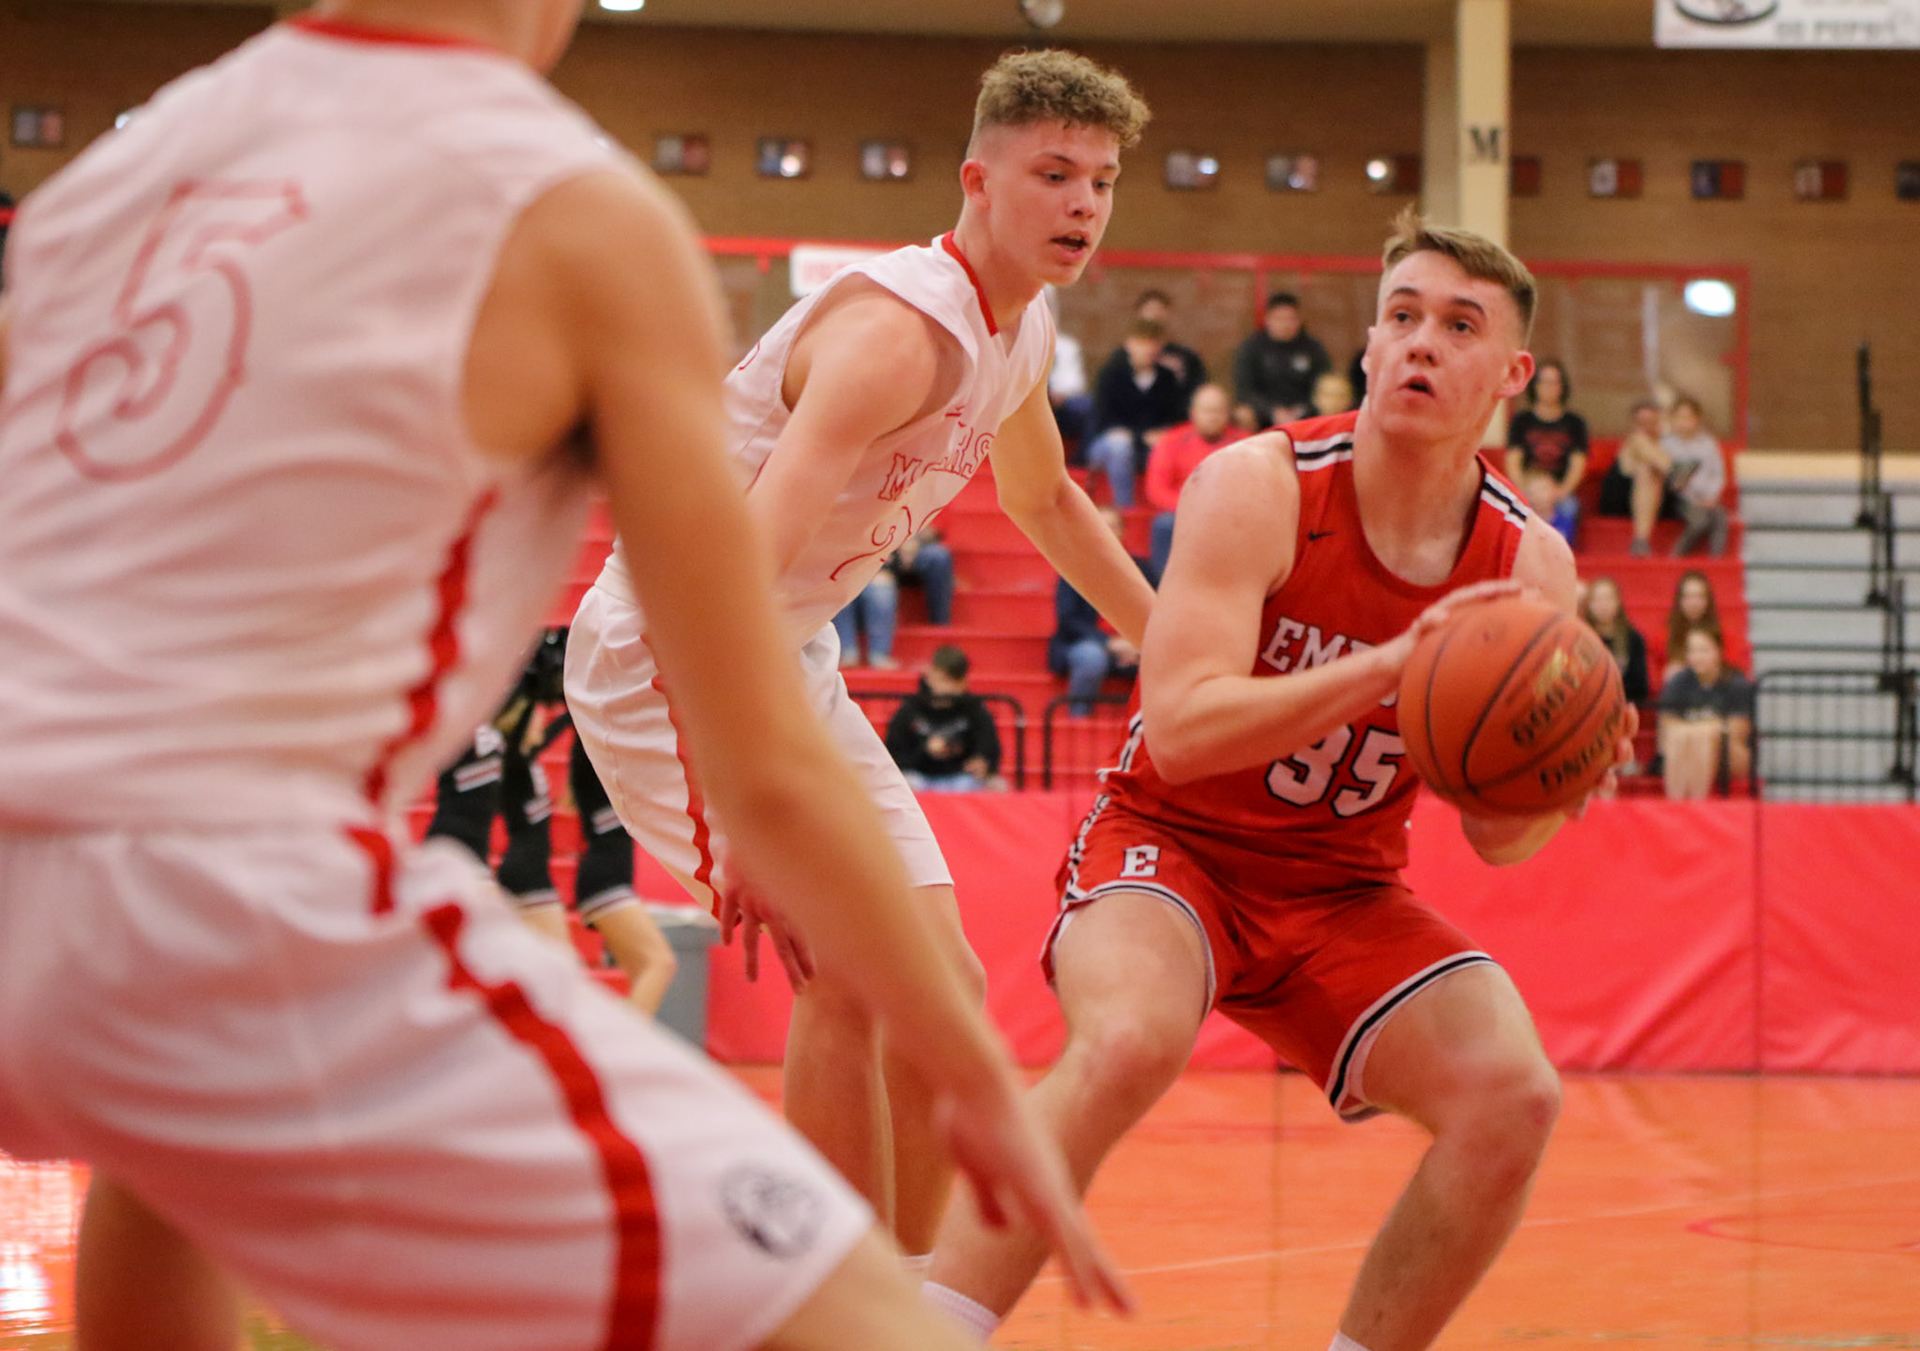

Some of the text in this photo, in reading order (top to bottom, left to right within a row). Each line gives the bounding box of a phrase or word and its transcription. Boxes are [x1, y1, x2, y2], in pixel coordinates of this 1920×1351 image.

[1469, 126, 1502, 165] M
[55, 177, 311, 484] 5
[1264, 723, 1406, 818] 35
[1119, 844, 1160, 878] E
